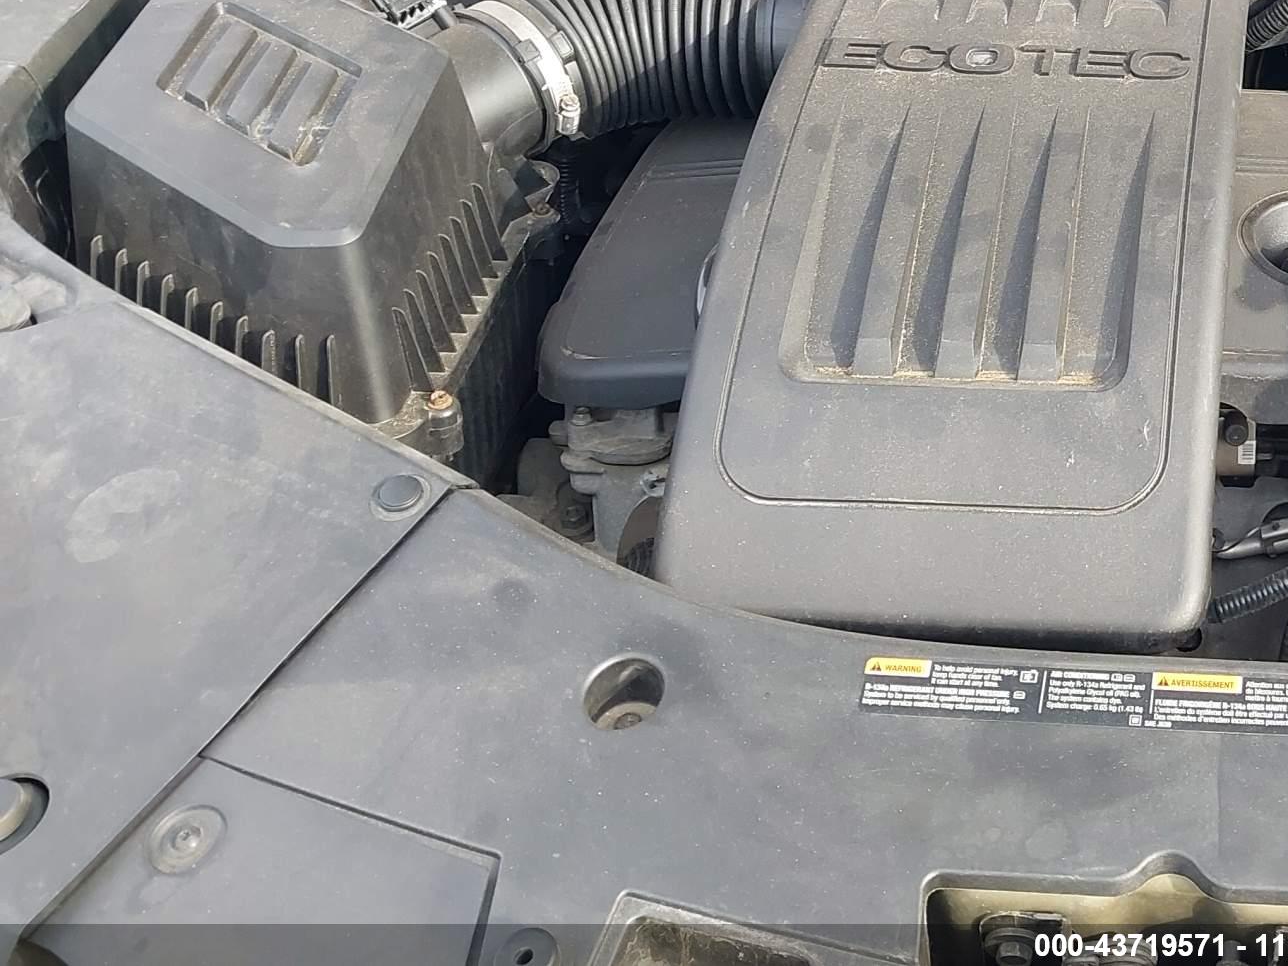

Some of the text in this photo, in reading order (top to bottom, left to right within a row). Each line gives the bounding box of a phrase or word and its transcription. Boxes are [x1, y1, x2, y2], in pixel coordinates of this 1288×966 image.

[817, 39, 1190, 79] ECOTEC
[884, 664, 923, 674] WARNING
[1170, 679, 1235, 689] AVERTISSEMENT
